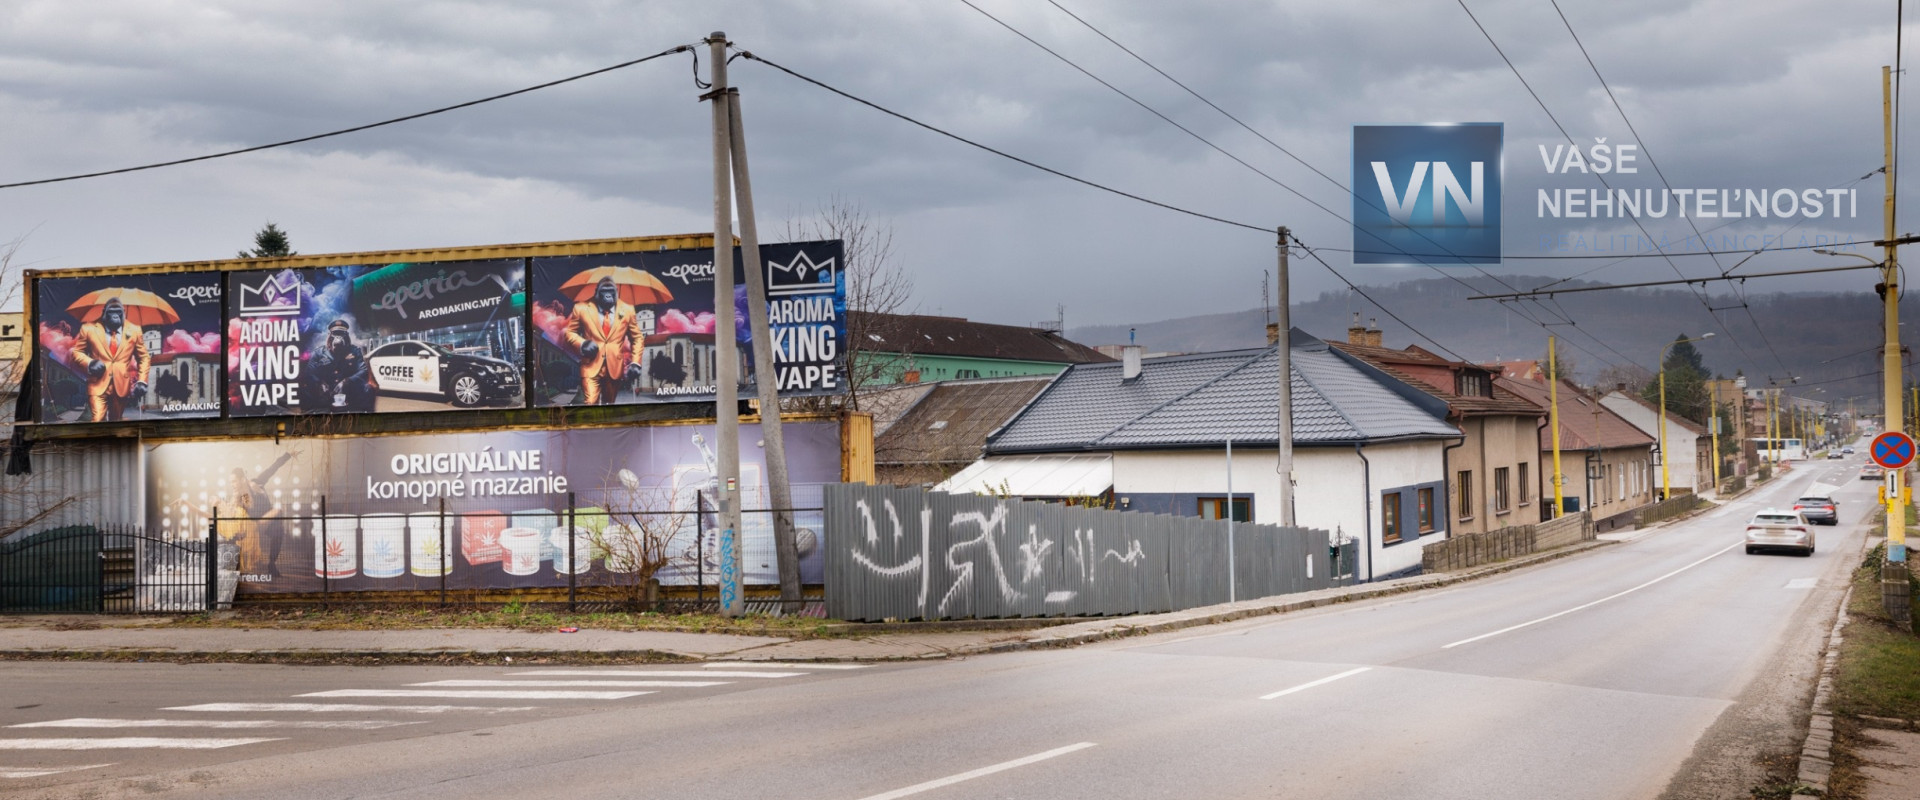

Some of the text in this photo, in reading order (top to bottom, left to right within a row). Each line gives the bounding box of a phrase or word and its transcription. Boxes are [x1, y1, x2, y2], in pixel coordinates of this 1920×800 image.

[661, 260, 715, 285] eperi
[168, 283, 221, 306] eperi
[370, 269, 491, 319] eperia
[418, 296, 502, 319] AROMAKING.WTF
[768, 298, 836, 324] AROMA
[240, 319, 300, 344] AROMA
[769, 325, 836, 363] KING
[240, 345, 300, 381] KING
[378, 365, 414, 378] COFFEE
[774, 365, 836, 390] VAPE
[240, 383, 300, 407] VAPE
[656, 385, 738, 396] AROMAKING
[162, 401, 220, 412] AROMAKING
[391, 446, 541, 475] ORIGINÁLNE
[367, 470, 568, 504] konopné mazanie
[241, 573, 273, 582] ren.eu
